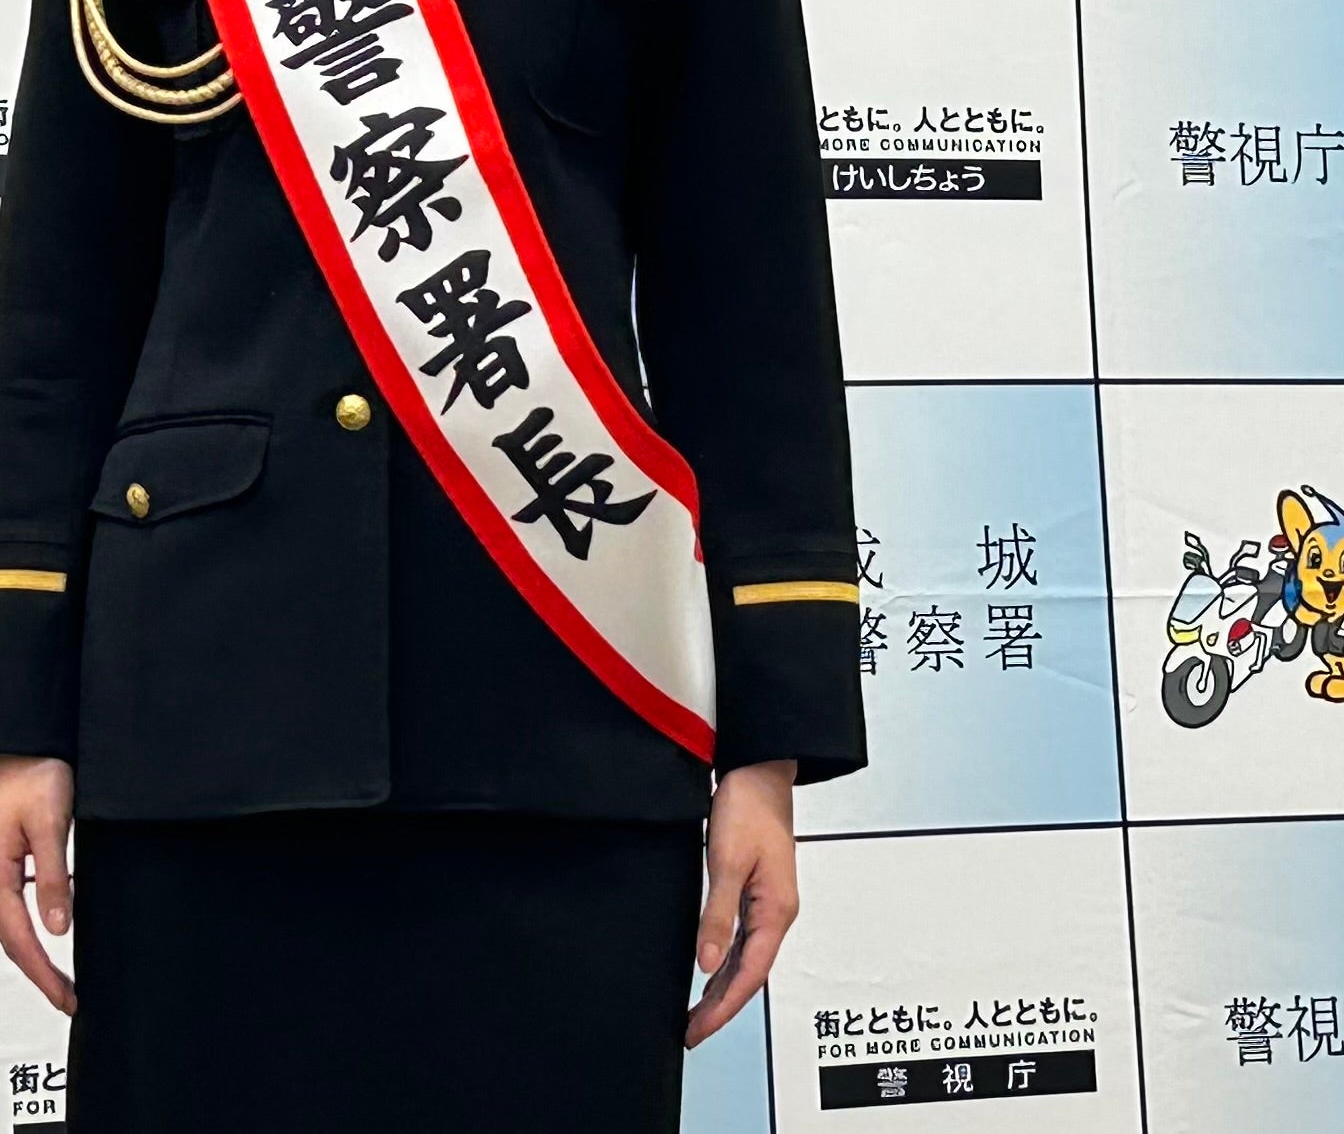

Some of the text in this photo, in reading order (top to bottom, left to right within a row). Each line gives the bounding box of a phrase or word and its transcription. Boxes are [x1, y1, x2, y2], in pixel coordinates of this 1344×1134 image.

[819, 106, 1044, 133] ともに。人とともに。
[880, 139, 1040, 152] COMMUNICATION
[1169, 121, 1344, 186] 警視庁
[833, 164, 985, 192] けいしちょう
[814, 997, 1097, 1039] 街とともに。人とともに。
[819, 1028, 1094, 1058] FOR MORE COMMUNICATION
[878, 1060, 1035, 1097] 警視庁
[13, 1099, 56, 1117] FOR
